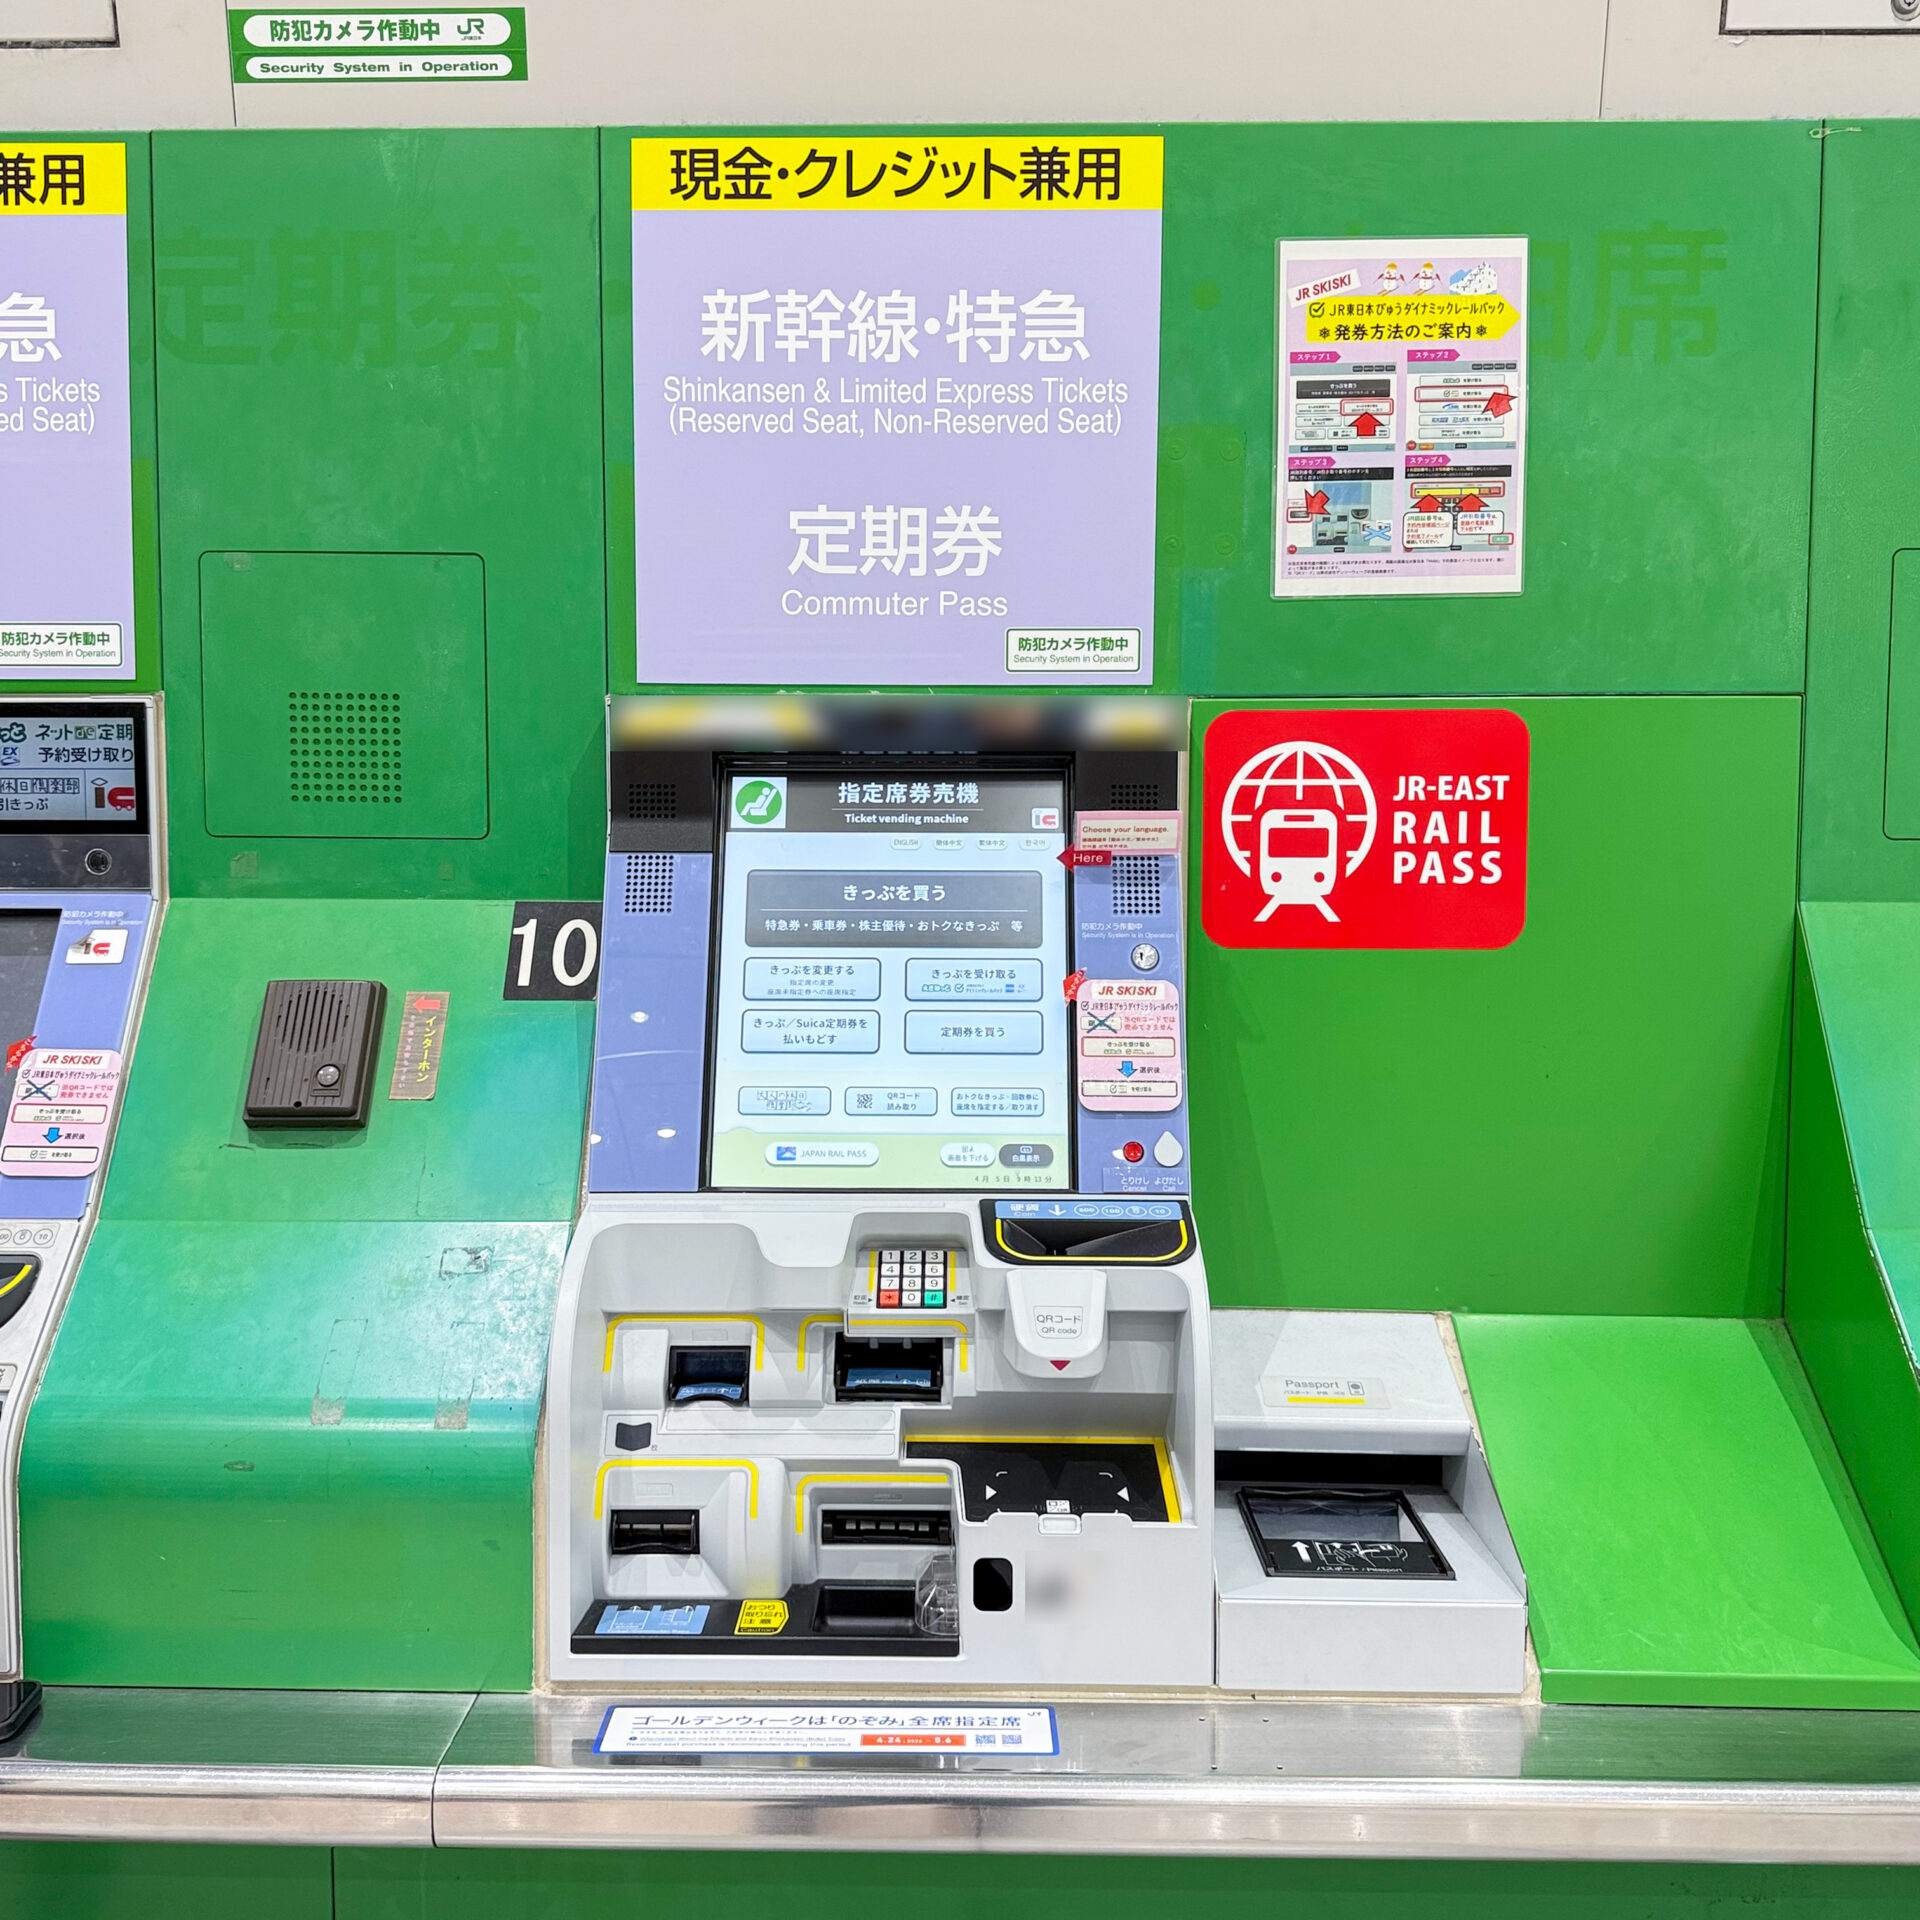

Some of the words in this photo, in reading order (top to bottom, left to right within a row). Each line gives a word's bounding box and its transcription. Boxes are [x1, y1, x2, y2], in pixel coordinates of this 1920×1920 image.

[269, 19, 440, 42] 防犯カメラ作動中
[456, 18, 484, 35] JR
[260, 62, 324, 75] Security
[333, 62, 390, 76] System
[399, 61, 412, 72] in
[421, 61, 499, 75] Operation
[0, 152, 84, 206] 兼用
[670, 146, 1121, 201] 現金・クレジット兼用
[1295, 286, 1311, 301] JR
[700, 288, 1090, 363] 新幹線・特急
[1335, 323, 1472, 340] 発券方法のご案内
[1297, 353, 1331, 361] ステップ1
[1415, 351, 1449, 359] ステップ2
[15, 377, 101, 402] Tickets
[664, 376, 805, 403] Shinkansen
[814, 378, 831, 403] &
[840, 378, 926, 403] Limited
[936, 379, 1034, 409] Express
[1041, 377, 1128, 403] Tickets
[33, 404, 95, 435] Seat)
[669, 403, 793, 436] (Reserved
[802, 407, 865, 438] Seat,
[874, 406, 1049, 434] Non-Reserved
[1057, 405, 1122, 436] Seat)
[1293, 458, 1327, 466] ステップ3
[1410, 456, 1444, 464] ステップ4
[787, 504, 1003, 578] 定期券
[781, 590, 929, 618] Commuter
[939, 590, 1008, 618] Pass
[1, 632, 110, 646] 防犯カメラ作動中
[1018, 637, 1129, 651] 防犯カメラ作動中
[33, 649, 63, 660] System
[66, 649, 73, 658] in
[76, 649, 116, 660] Operation
[1013, 654, 1047, 664] Security
[1049, 654, 1081, 664] System
[1083, 655, 1091, 663] in
[1092, 654, 1134, 664] Operation
[38, 747, 134, 763] 予約受け取り
[838, 782, 979, 804] 指定席券売機
[1392, 774, 1510, 801] JR-EAST
[845, 813, 877, 824] Ticket
[879, 814, 921, 825] vending
[923, 813, 969, 824] machine
[1113, 826, 1131, 834] your
[1133, 825, 1168, 834] language.
[1393, 811, 1501, 844] RAIL
[1072, 854, 1104, 863] Here
[1393, 850, 1503, 885] PASS
[842, 884, 946, 901] きっぷを買う
[1081, 922, 1143, 931] 防犯カメラ作動中
[512, 918, 598, 987] 10
[770, 965, 855, 975] きっぷを変更する
[931, 969, 1016, 979] きっぷを受け取る
[1098, 986, 1113, 995] JR
[1116, 985, 1157, 996] SKISKI
[941, 1027, 1005, 1038] 定期券を買う
[783, 1034, 838, 1045] 払いもどす
[416, 1016, 437, 1082] インターホン
[43, 1055, 59, 1064] JR
[61, 1055, 103, 1065] SKISKI
[887, 1092, 920, 1100] QRコード
[887, 1103, 917, 1111] 読み取り
[800, 1150, 826, 1158] JAPAN
[828, 1150, 845, 1158] RAIL
[847, 1150, 867, 1158] PASS
[1120, 1176, 1150, 1185] とりけし
[1154, 1176, 1184, 1185] よびだし
[888, 1252, 893, 1260] 1
[908, 1252, 917, 1260] 2
[930, 1252, 938, 1260] 3
[887, 1265, 894, 1274] 4
[908, 1265, 917, 1274] 5
[930, 1265, 938, 1274] 6
[887, 1279, 894, 1288] 7
[908, 1279, 917, 1288] 8
[930, 1279, 938, 1288] 9
[908, 1293, 917, 1301] 0
[1036, 1314, 1081, 1324] QRコード
[1285, 1379, 1340, 1390] Passport
[632, 1715, 1022, 1727] ゴールデンウィークは「のぞみ」全席指定席
